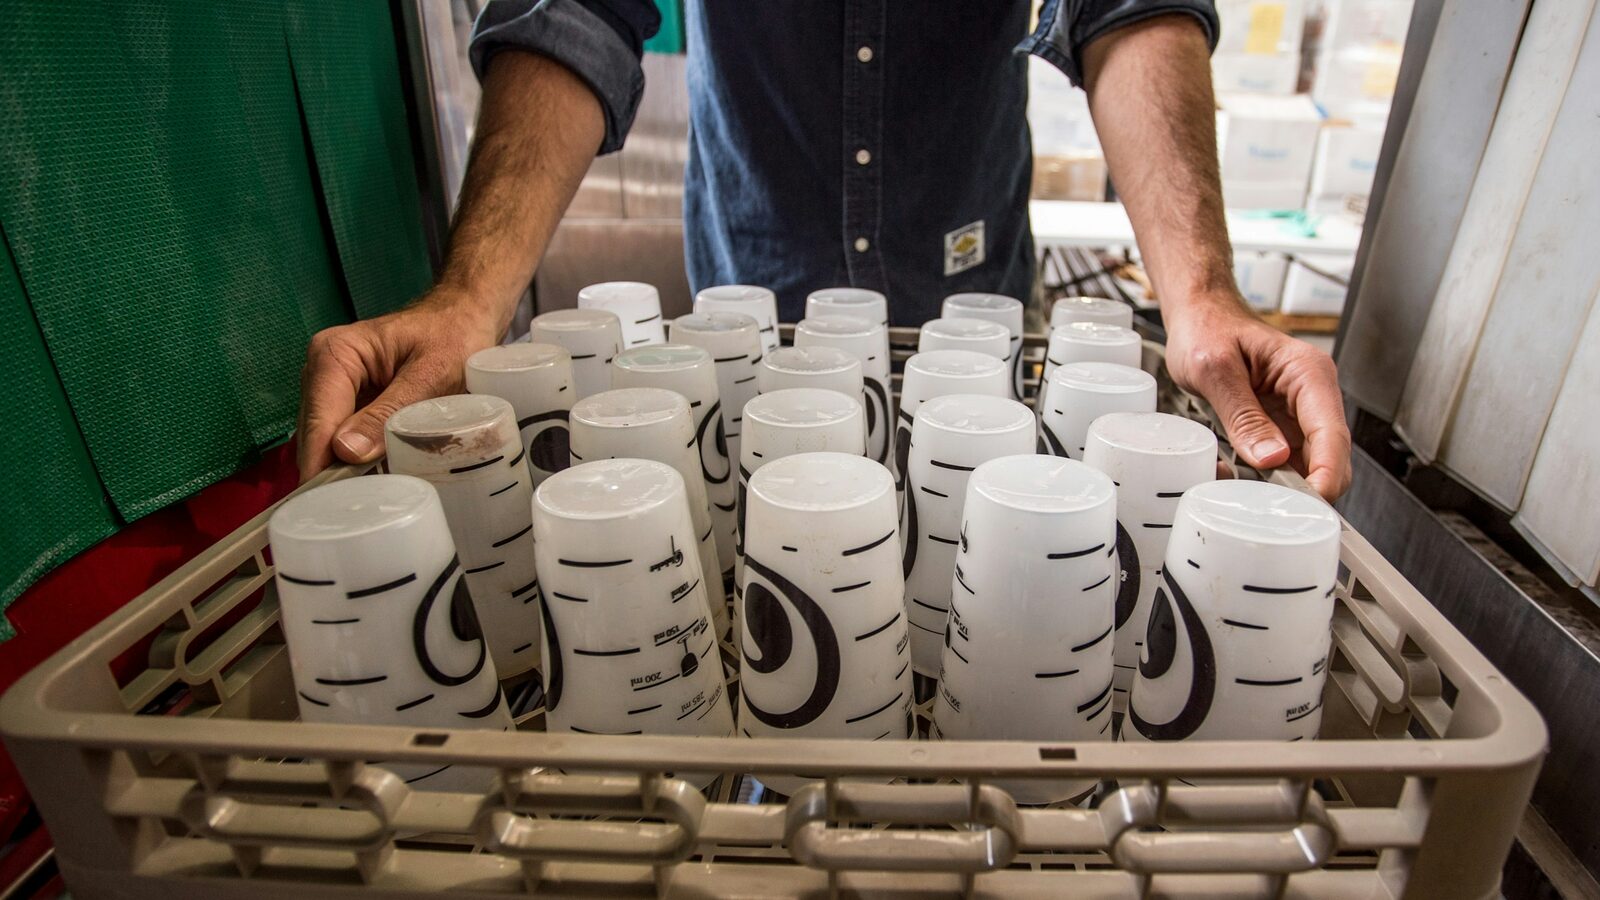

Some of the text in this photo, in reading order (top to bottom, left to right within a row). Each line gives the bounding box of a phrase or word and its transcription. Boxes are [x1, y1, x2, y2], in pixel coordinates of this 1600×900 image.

[654, 625, 680, 643] 150 ml
[630, 672, 662, 687] 200 ml
[681, 691, 705, 713] 285 ml
